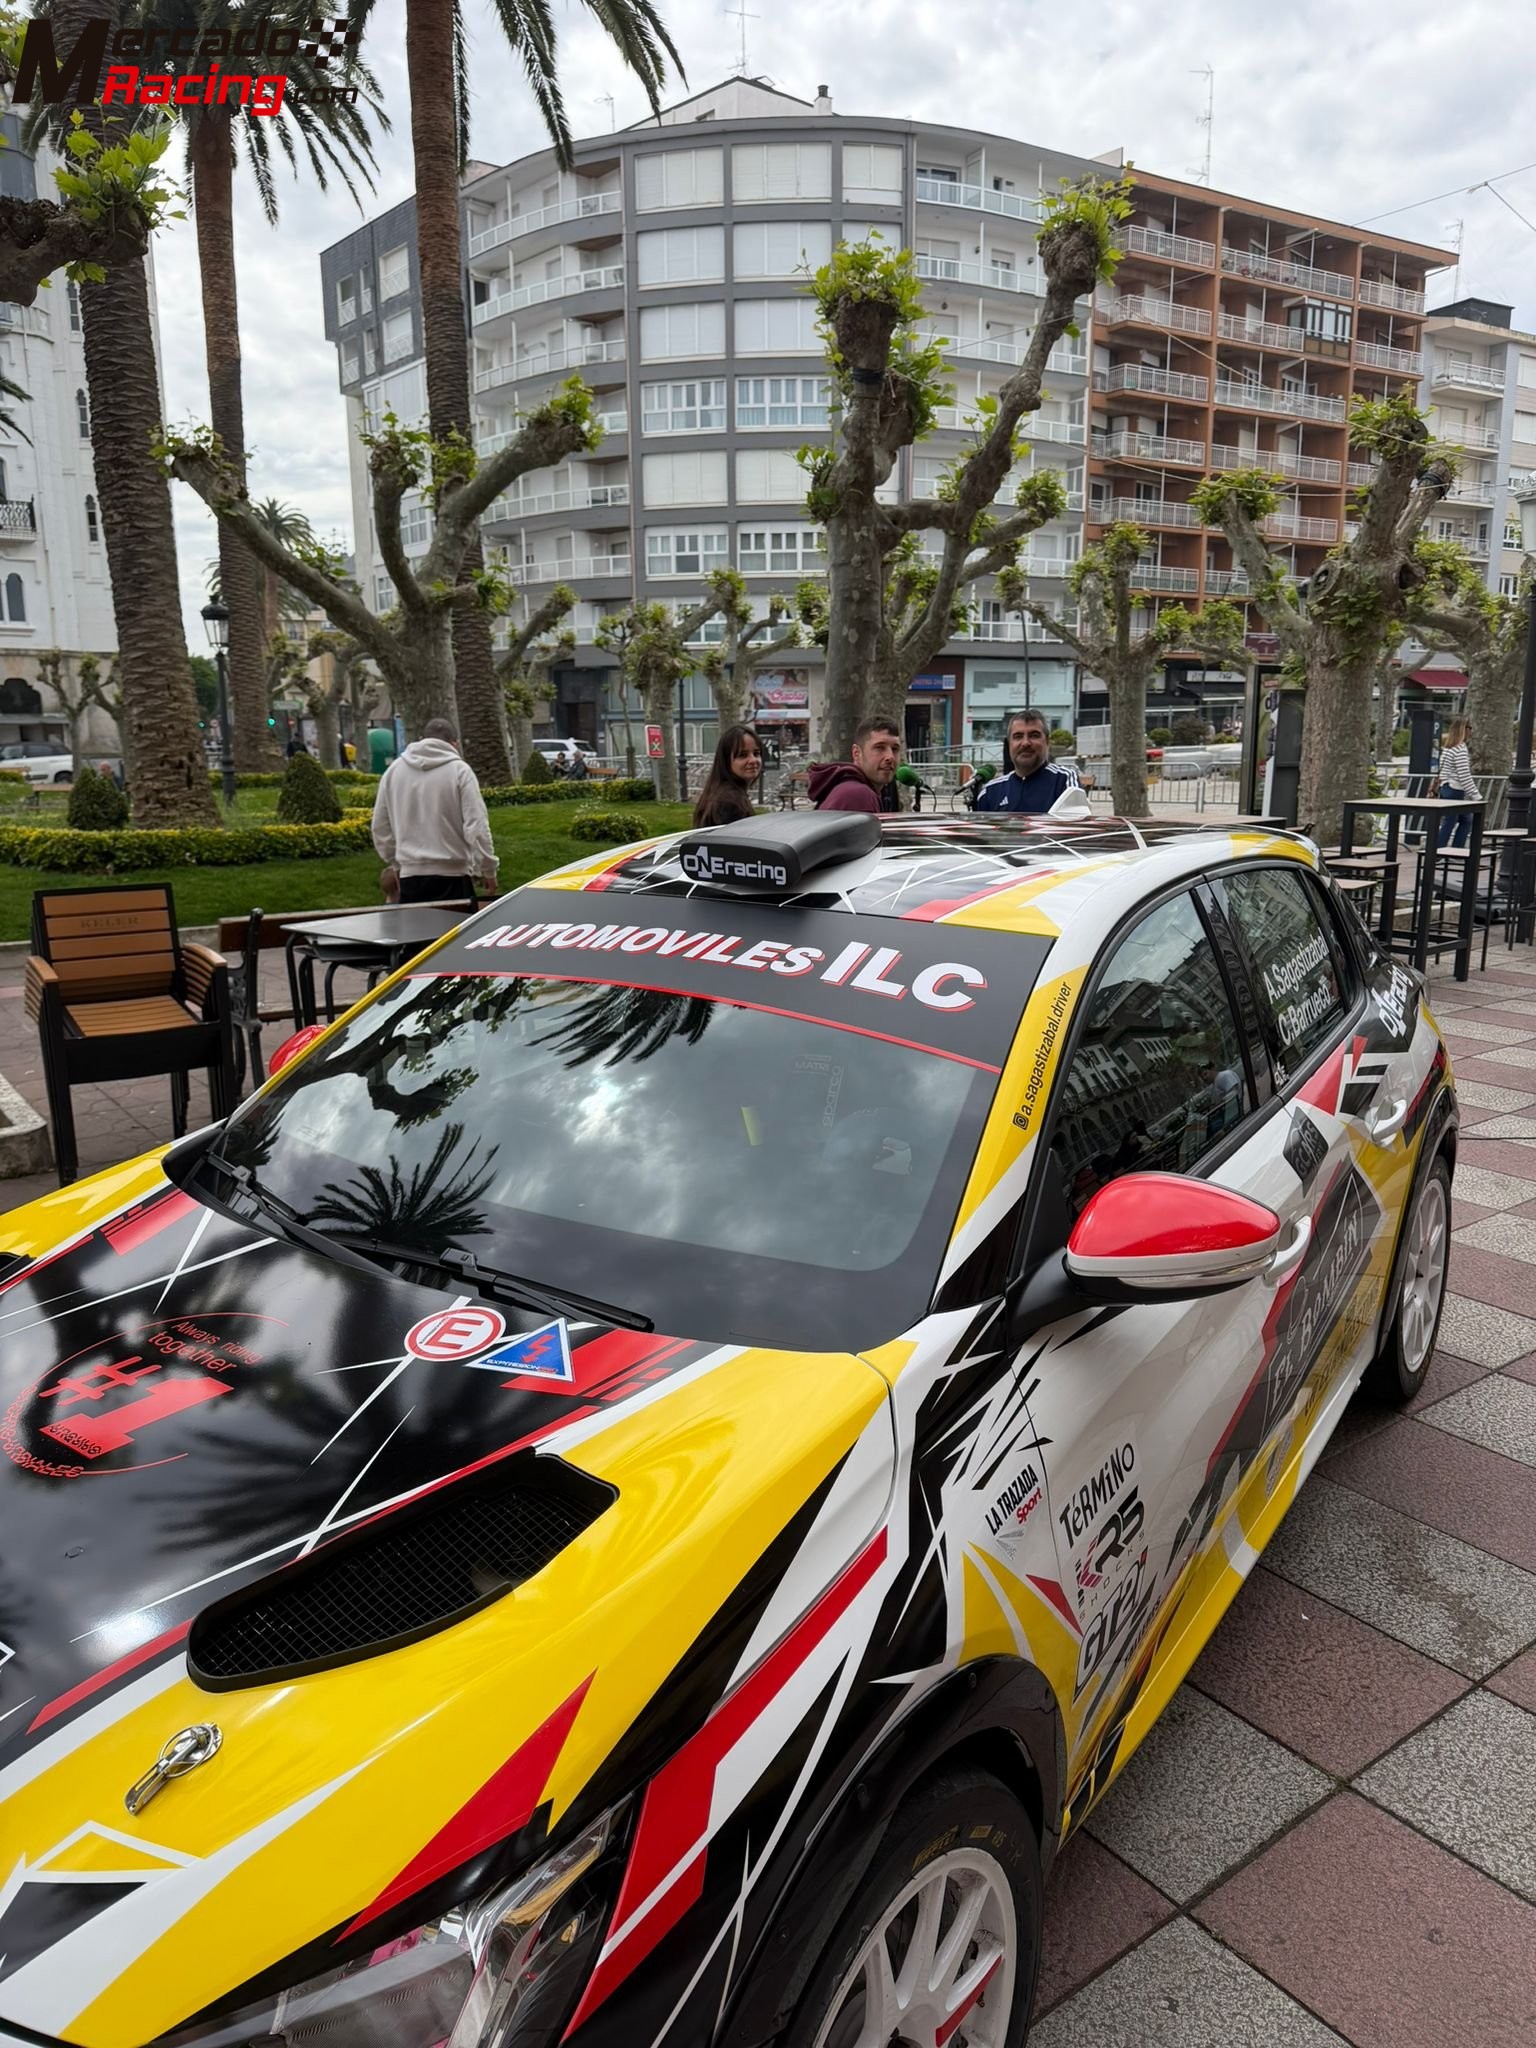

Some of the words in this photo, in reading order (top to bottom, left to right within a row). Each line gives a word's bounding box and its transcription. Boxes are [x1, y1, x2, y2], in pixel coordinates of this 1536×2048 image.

[464, 922, 826, 977] AUTOMOVILES
[820, 941, 988, 1012] ILC
[1021, 981, 1072, 1116] a.sagastizabal.driver
[148, 1331, 238, 1373] together
[171, 1321, 220, 1345] Always
[220, 1341, 263, 1365] riding
[424, 1317, 485, 1351] E
[985, 1506, 1003, 1536] LA
[997, 1464, 1039, 1520] TRAZADA
[1016, 1487, 1042, 1525] Sport
